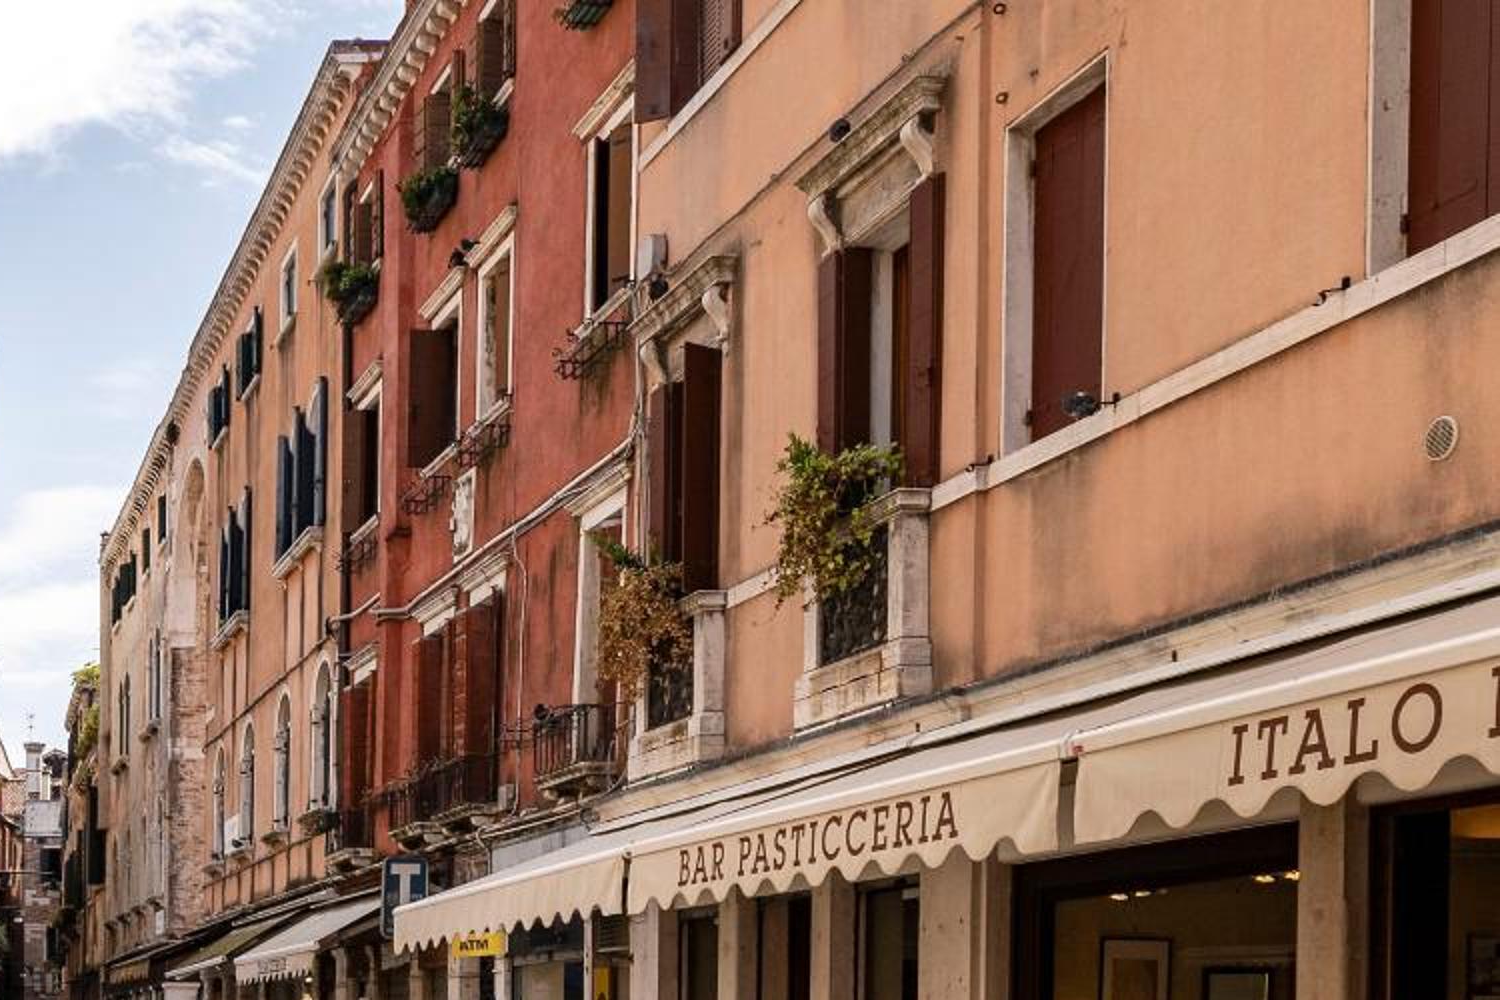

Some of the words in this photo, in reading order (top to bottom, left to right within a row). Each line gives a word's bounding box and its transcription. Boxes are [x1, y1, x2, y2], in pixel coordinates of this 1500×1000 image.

[1228, 683, 1443, 786] ITALO
[678, 842, 725, 887] BAR
[737, 791, 959, 876] PASTICCERIA
[390, 863, 421, 905] T
[459, 939, 489, 951] ATM
